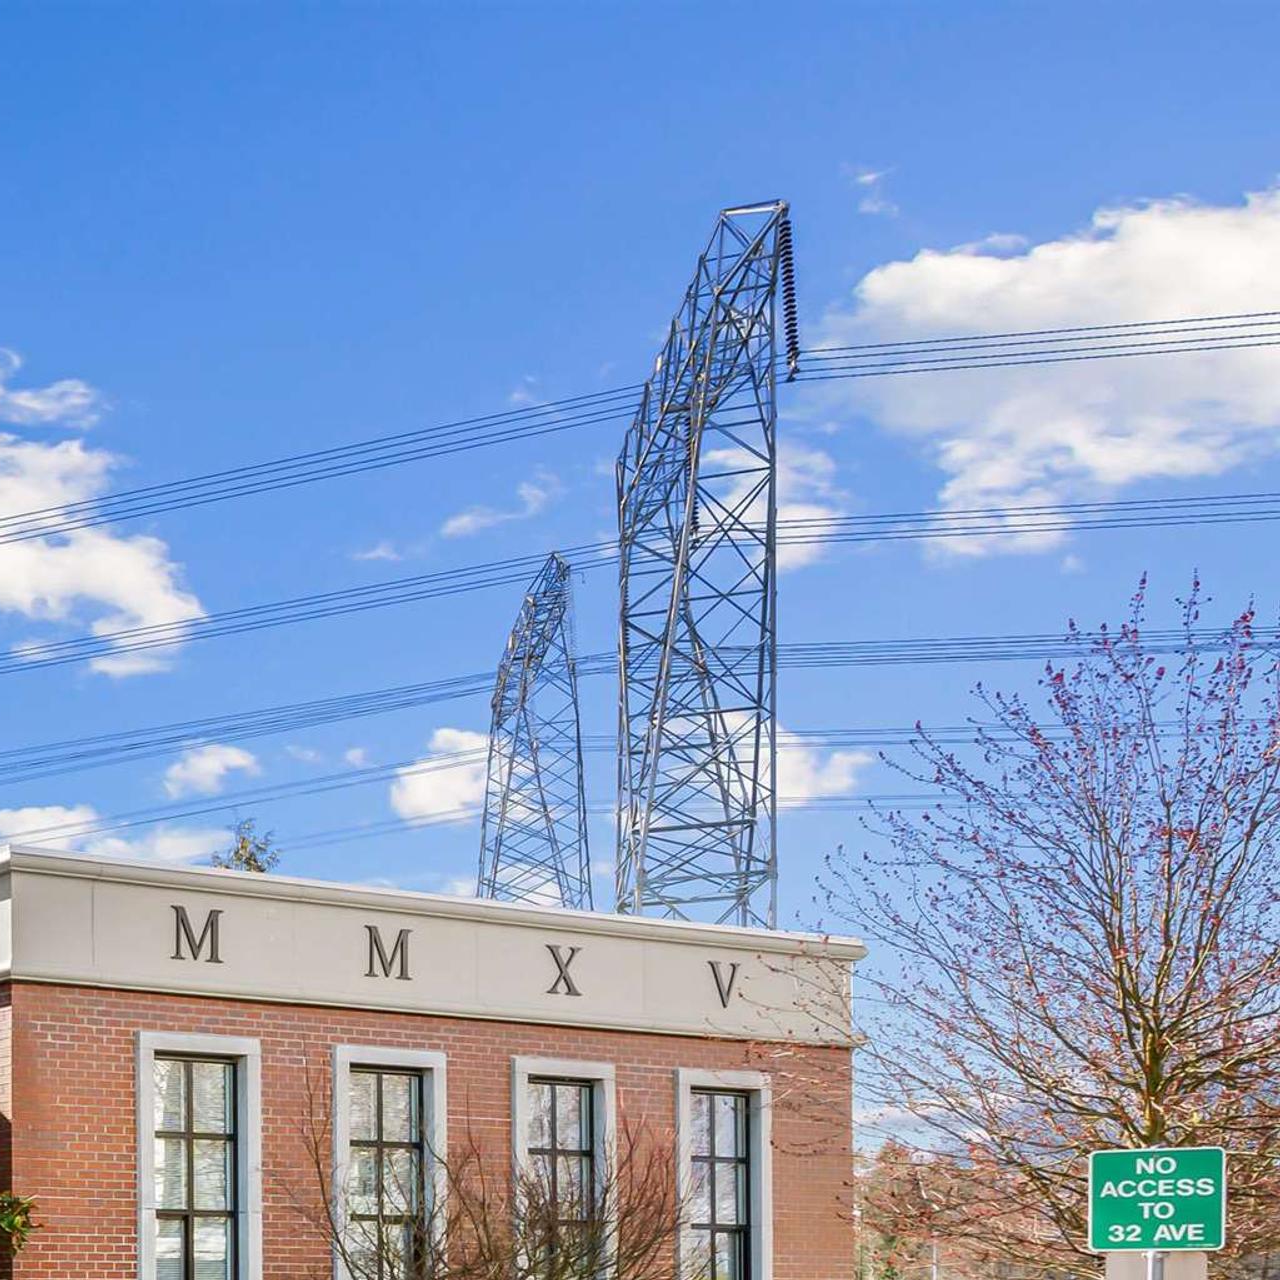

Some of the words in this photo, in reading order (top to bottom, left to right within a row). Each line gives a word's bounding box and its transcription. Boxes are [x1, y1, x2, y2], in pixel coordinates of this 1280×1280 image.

[1135, 1156, 1177, 1175] NO
[1100, 1177, 1215, 1198] ACCESS
[1137, 1201, 1175, 1219] TO
[1107, 1224, 1142, 1242] 32
[1153, 1223, 1205, 1241] AVE
